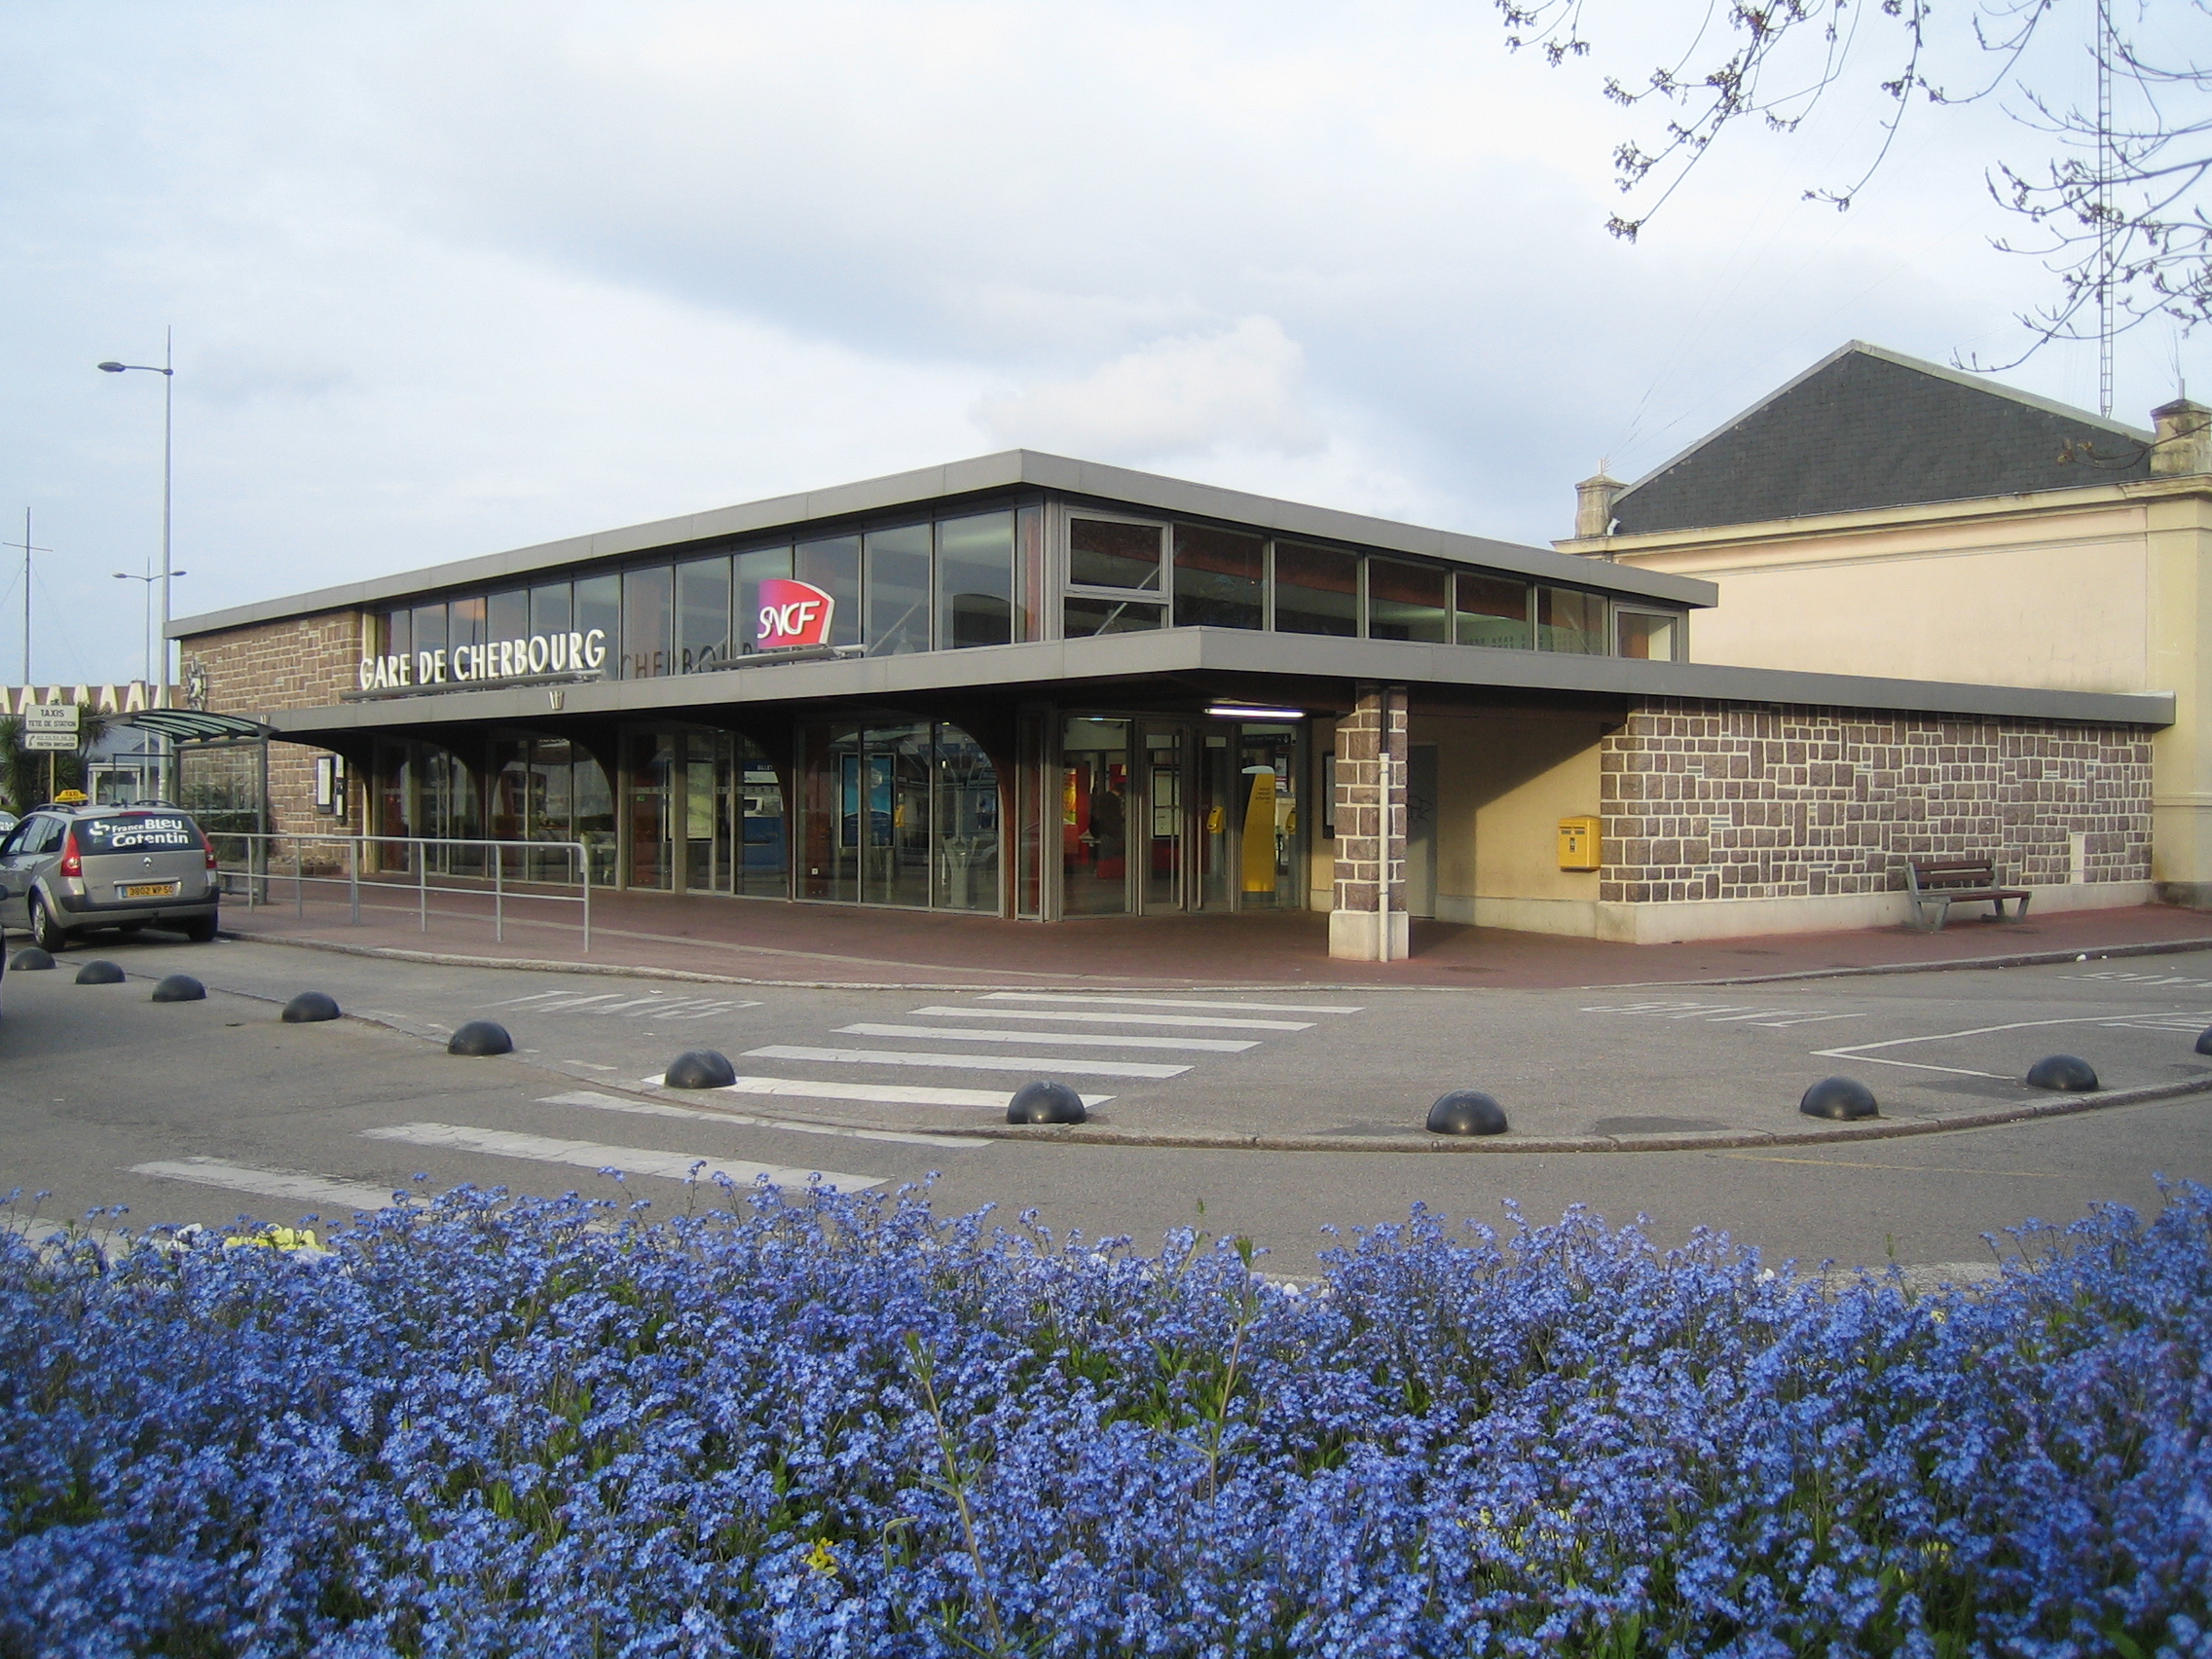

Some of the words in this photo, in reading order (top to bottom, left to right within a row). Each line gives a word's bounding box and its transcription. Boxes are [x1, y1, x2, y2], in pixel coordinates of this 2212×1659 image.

[756, 600, 821, 639] SNCF
[359, 653, 411, 691] GARE
[419, 649, 446, 684] DE
[454, 628, 606, 682] CHERBOURG
[112, 832, 189, 847] Cotentin
[164, 885, 173, 894] 50
[472, 990, 765, 1020] TAXIS
